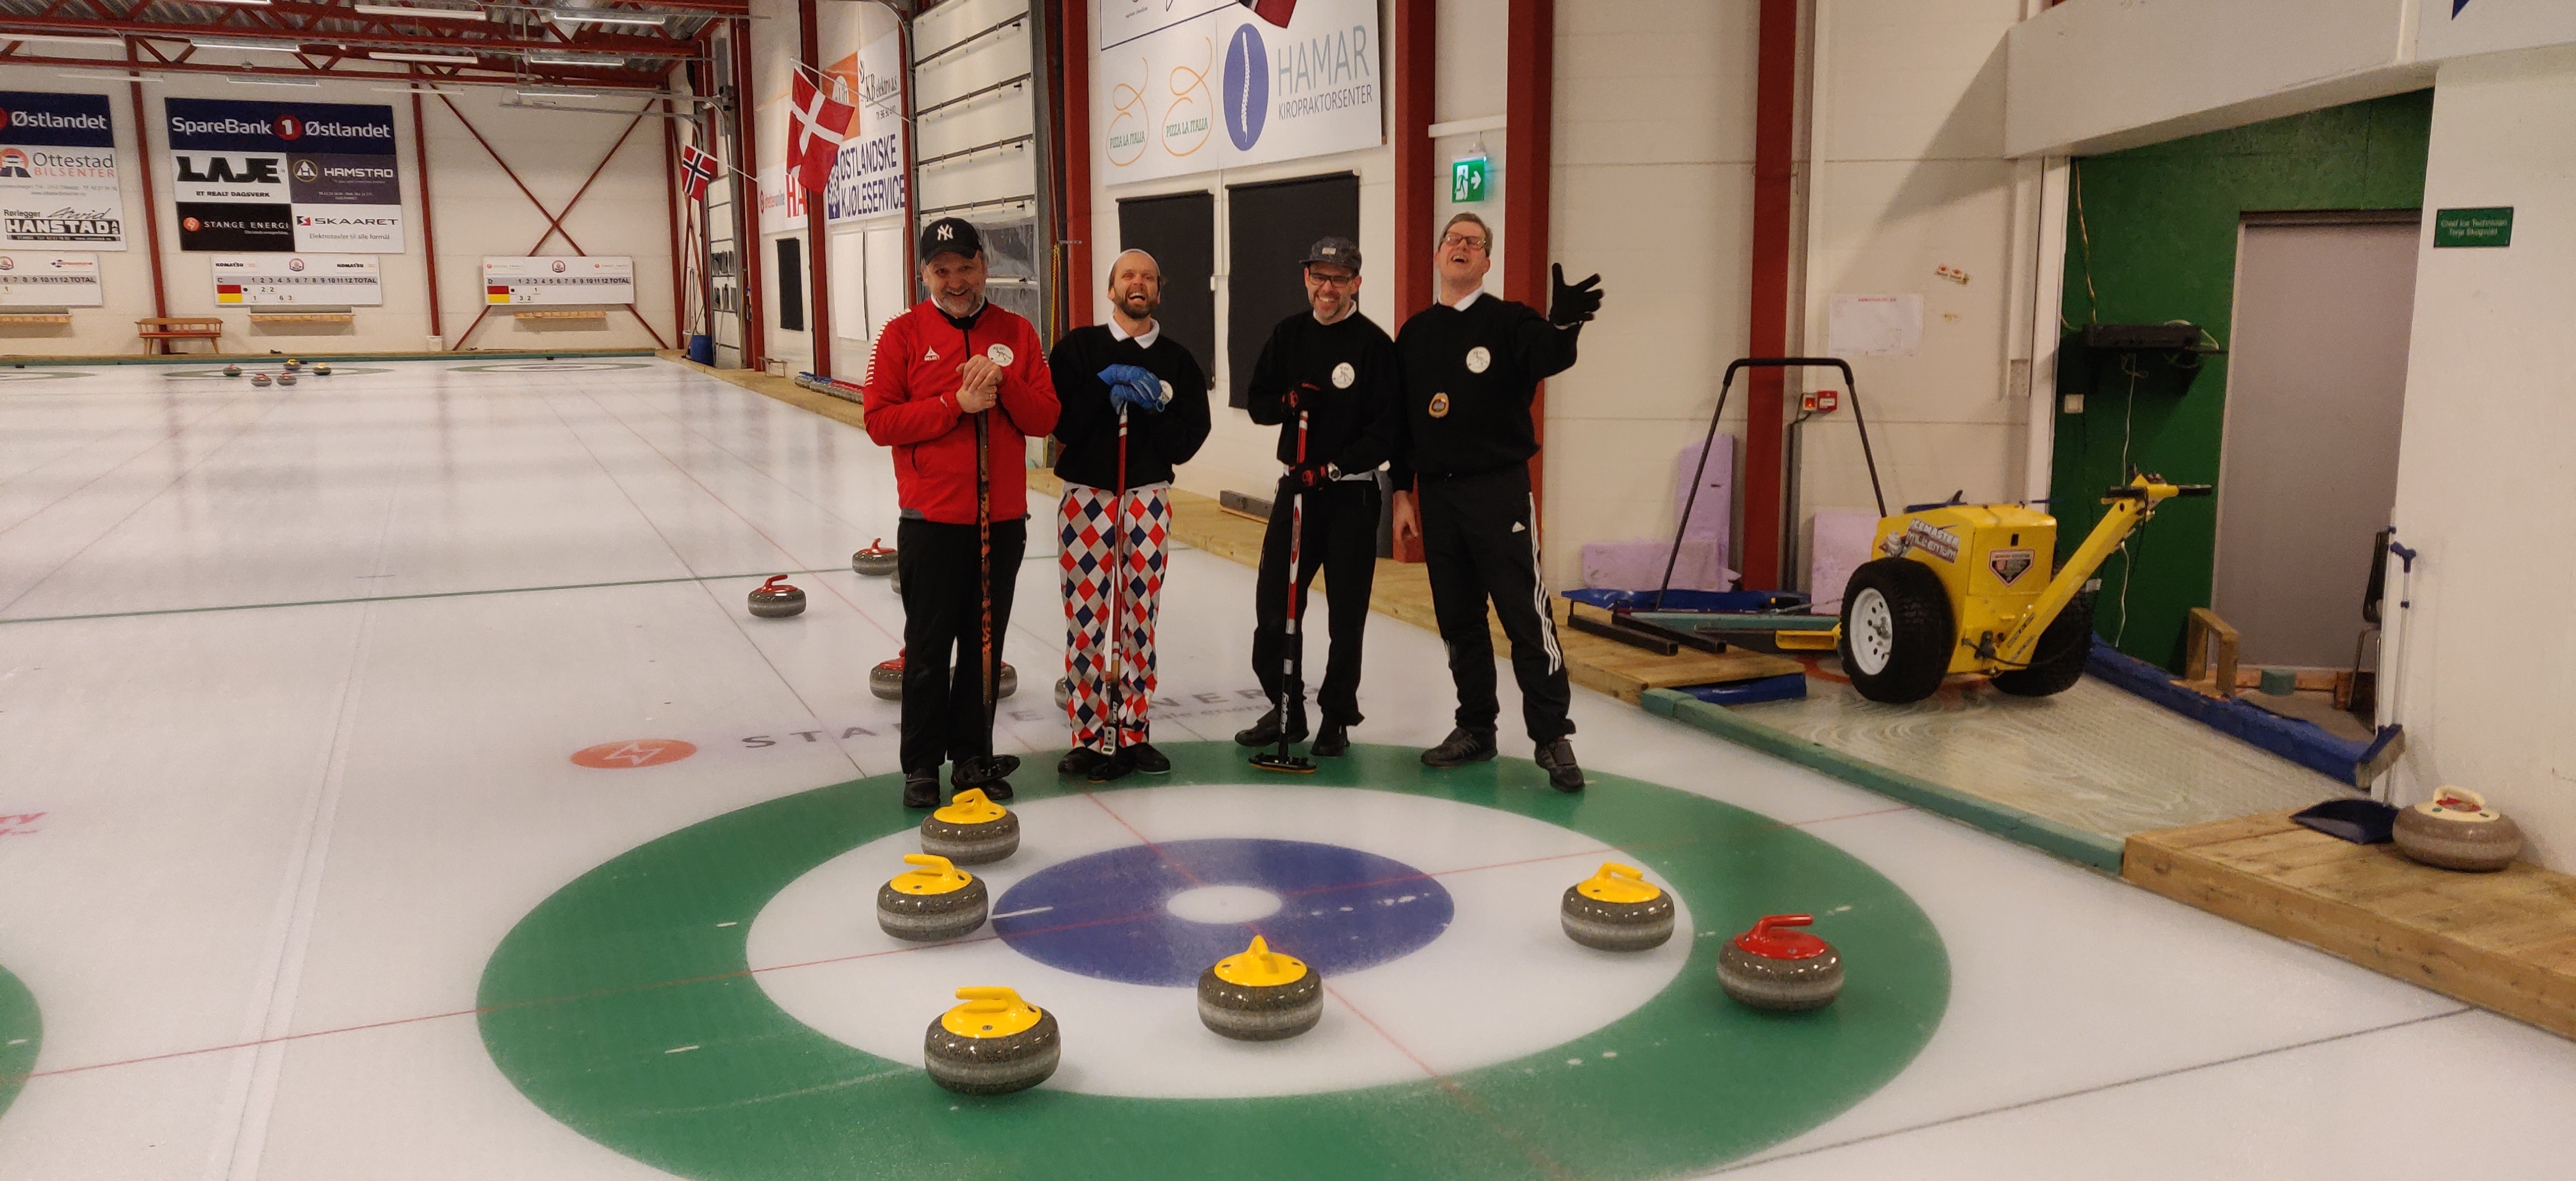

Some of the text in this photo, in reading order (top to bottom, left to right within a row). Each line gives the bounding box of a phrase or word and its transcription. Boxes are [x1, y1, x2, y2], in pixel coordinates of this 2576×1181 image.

[1278, 25, 1370, 96] HAMAR
[1278, 84, 1372, 120] KIROPRAKTORSENTER
[12, 111, 107, 129] Østlandet
[172, 117, 391, 138] SpareBank 1 Østlandet
[1166, 117, 1208, 137] PIZZA LA ITALIA
[1110, 131, 1145, 149] PIZZA LA ITALIA
[33, 152, 114, 168] Ottestad
[840, 134, 897, 182] ØSTLANDSKE
[34, 168, 115, 178] BILSENTER
[176, 156, 282, 183] LAJE
[324, 167, 394, 178] HAMSTAD
[841, 174, 905, 218] KJØLESERVICE
[4, 209, 41, 219] Rørlegger
[6, 219, 110, 234] HANSTAD
[937, 224, 954, 241] NY
